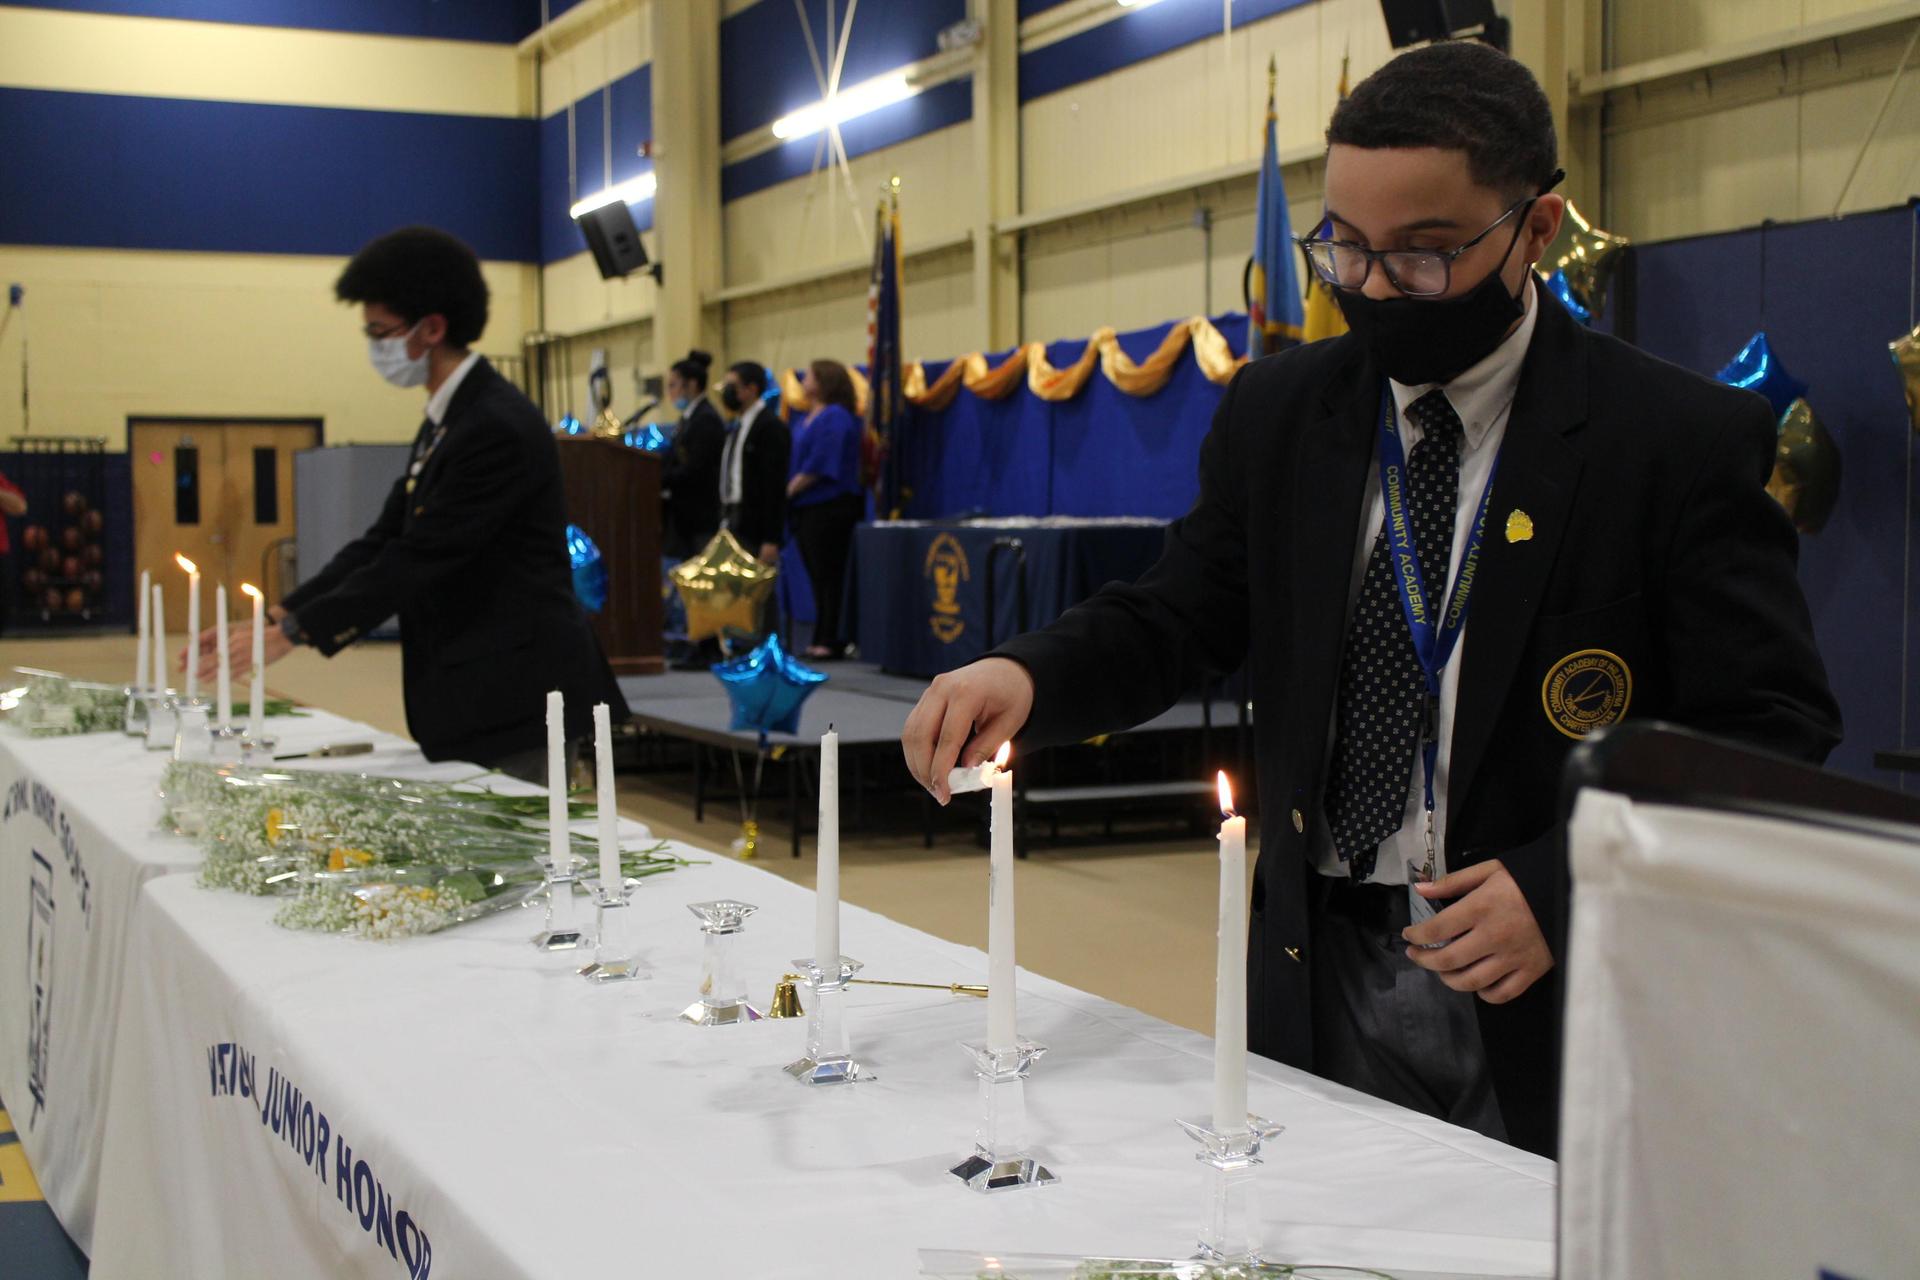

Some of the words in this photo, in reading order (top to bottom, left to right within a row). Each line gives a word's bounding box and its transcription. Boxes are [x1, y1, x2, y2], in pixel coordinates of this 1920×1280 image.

[1386, 465, 1410, 550] COMMUNITY
[1398, 553, 1428, 625] ACADEMY
[1446, 541, 1481, 630] COMMUNITY
[1564, 657, 1599, 675] ACADEMY
[262, 1066, 330, 1185] JUNIOR
